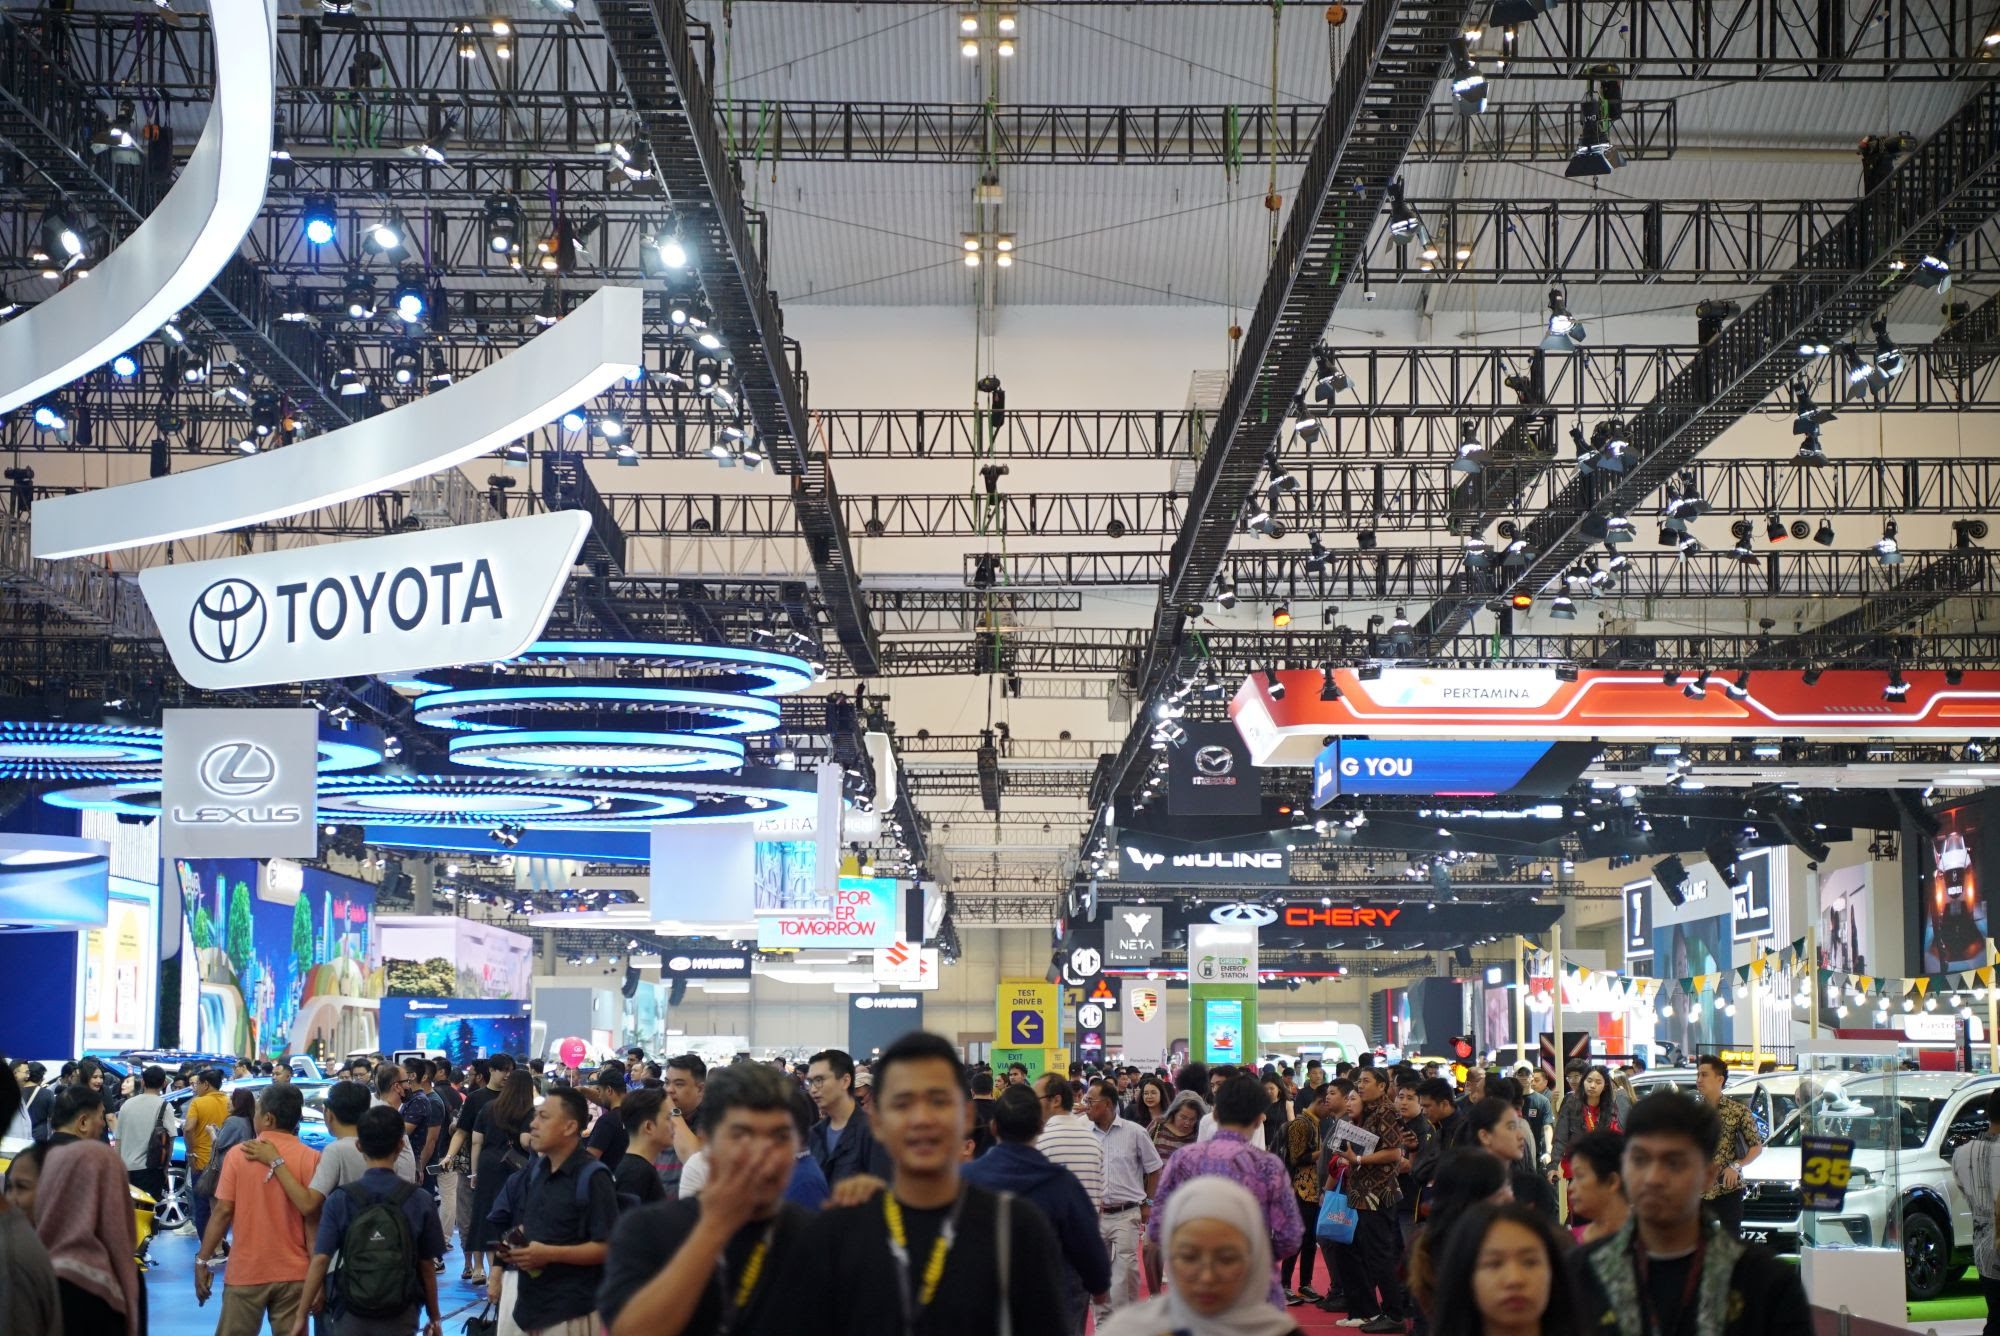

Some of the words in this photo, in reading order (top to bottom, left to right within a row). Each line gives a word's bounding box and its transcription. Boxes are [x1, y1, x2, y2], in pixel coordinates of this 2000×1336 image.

[277, 559, 502, 643] TOYOTA
[1443, 688, 1530, 698] PERTAMINA
[1340, 757, 1359, 776] G
[1364, 757, 1413, 776] YOU
[173, 807, 300, 823] LEXUS
[758, 816, 812, 831] ASTRA
[1173, 852, 1282, 868] WULING
[838, 890, 871, 905] FOR
[1285, 907, 1400, 927] CHERY
[778, 921, 876, 936] TOMORROW
[1119, 939, 1154, 950] NETA
[692, 957, 744, 970] HYUNDAI
[1018, 989, 1036, 997] TEST
[1803, 1157, 1850, 1187] 35
